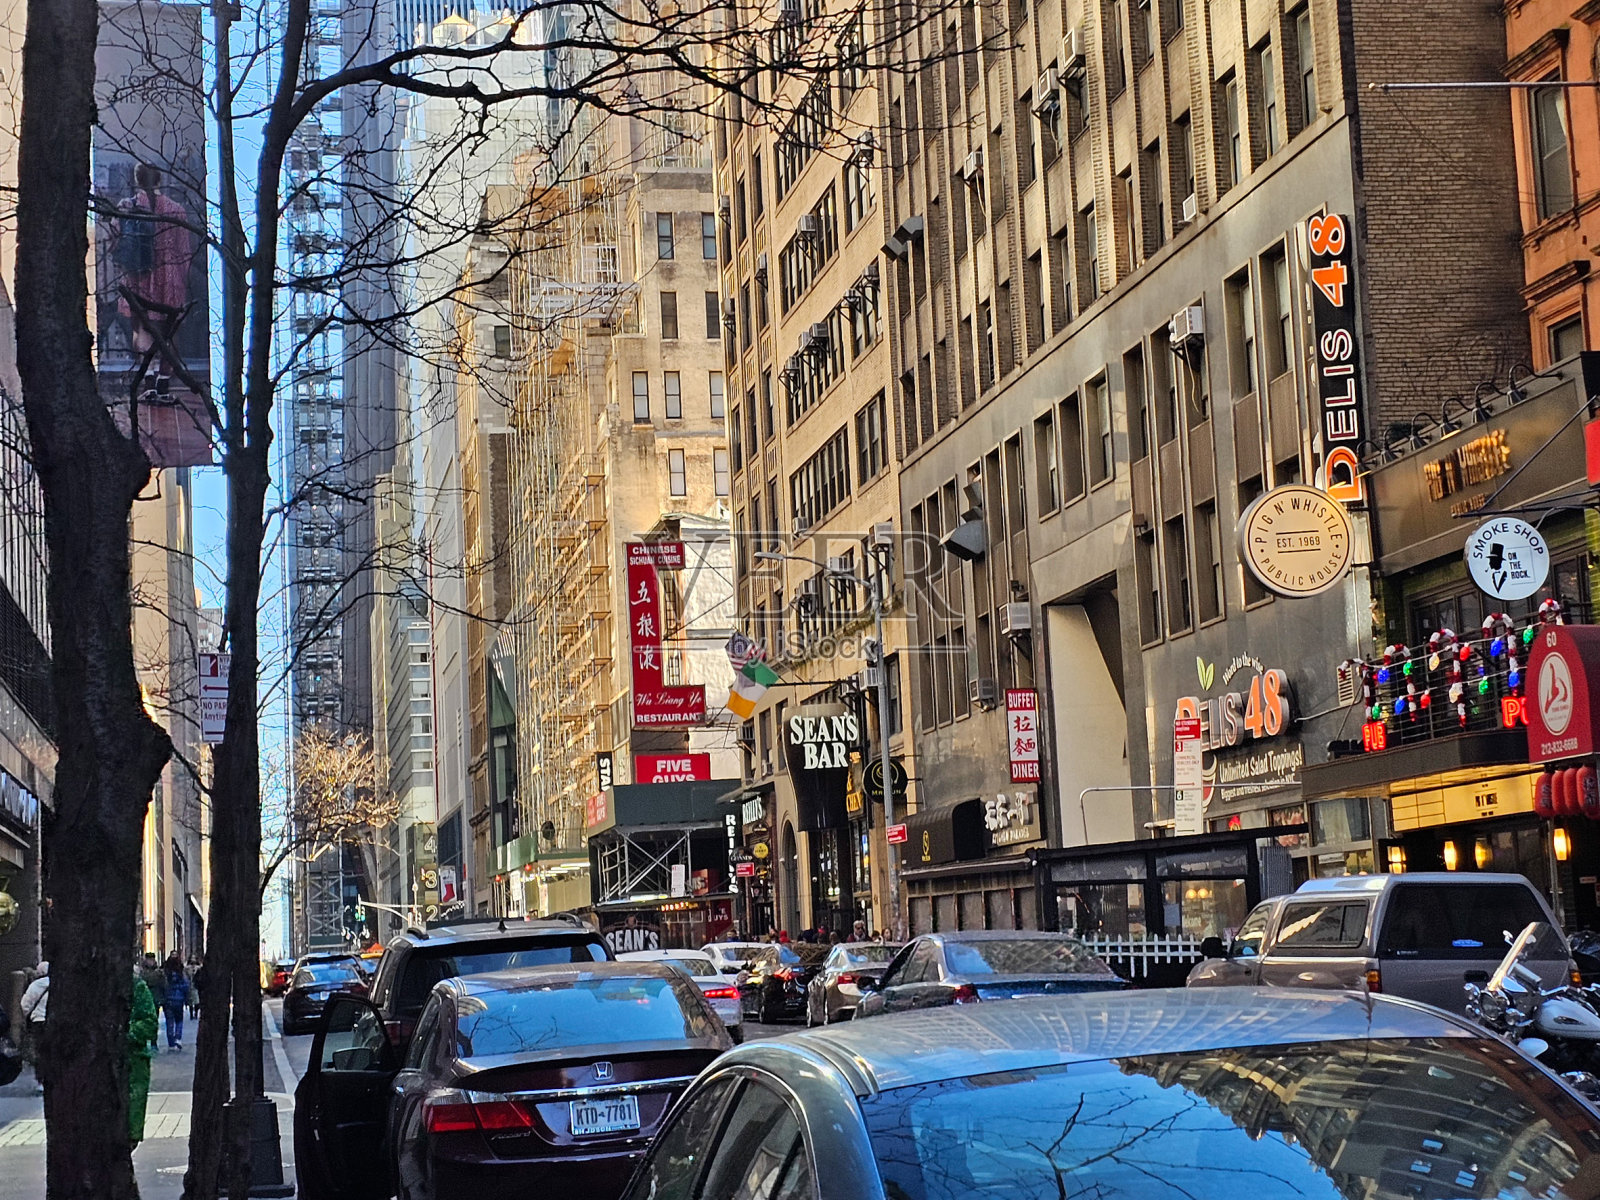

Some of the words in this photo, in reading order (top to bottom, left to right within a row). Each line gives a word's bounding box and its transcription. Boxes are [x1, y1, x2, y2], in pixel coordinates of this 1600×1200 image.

[1308, 213, 1348, 308] 48
[1318, 327, 1364, 502] DELIS
[1255, 515, 1274, 544] PIG
[1290, 498, 1343, 541] WHISTLE
[632, 545, 677, 555] CHINESE
[1276, 537, 1295, 549] EST.
[1299, 535, 1321, 547] 1969
[1473, 522, 1509, 559] SMOKE
[1514, 524, 1544, 556] SHOP
[1508, 552, 1518, 561] ON
[1509, 561, 1522, 570] THE
[1260, 557, 1304, 586] PUBLIC
[1309, 552, 1342, 585] HOUSE
[1546, 631, 1557, 647] 60
[1008, 692, 1035, 708] BUFFET
[1244, 669, 1289, 739] 48
[636, 712, 705, 723] RESTAURANT
[790, 711, 858, 745] SEAN'S
[803, 742, 849, 769] BAR
[1177, 742, 1182, 752] 3
[656, 759, 692, 773] FIVE
[1012, 763, 1040, 779] DINER
[1219, 756, 1250, 784] Unlimited
[1249, 752, 1269, 777] Salad
[1177, 790, 1182, 799] 6
[605, 929, 659, 952] SEAN'S
[576, 1107, 598, 1126] KTD
[604, 1104, 633, 1123] 7781
